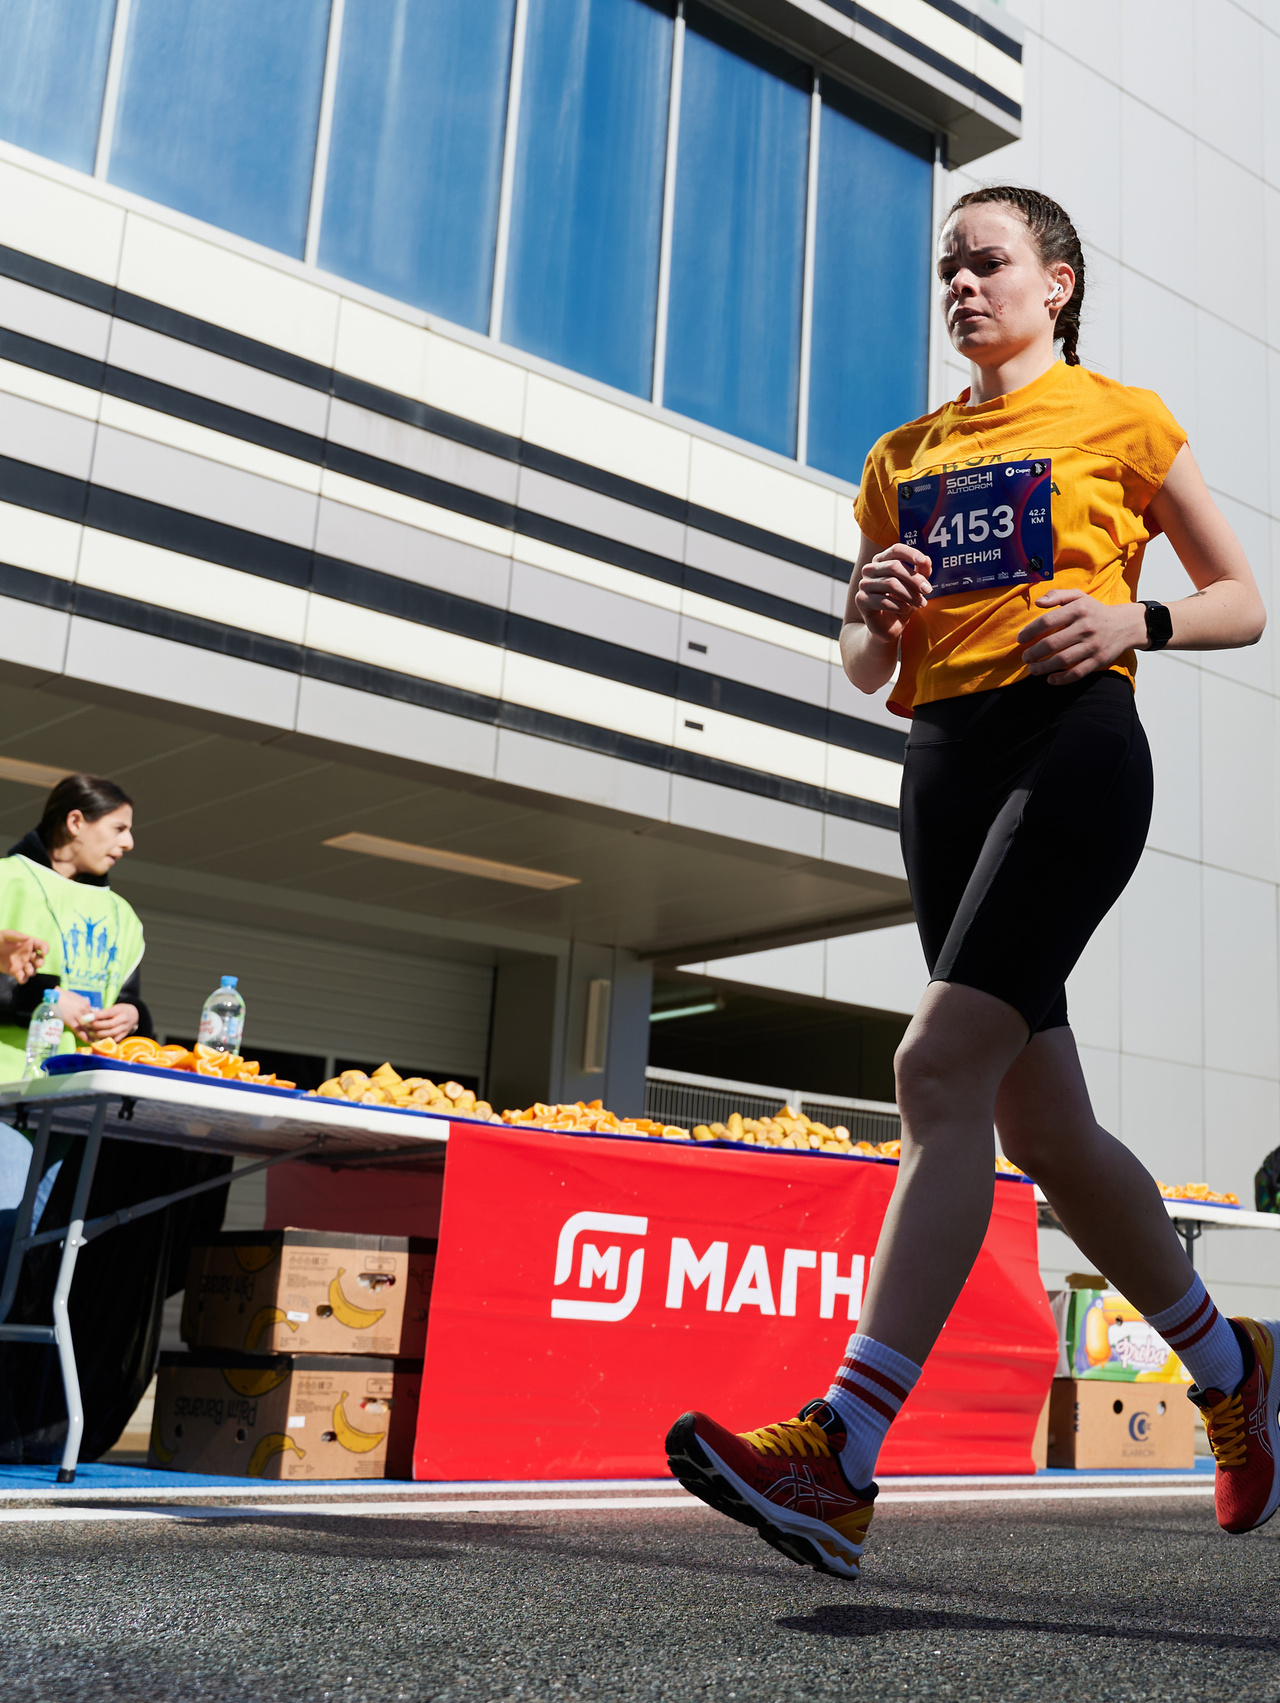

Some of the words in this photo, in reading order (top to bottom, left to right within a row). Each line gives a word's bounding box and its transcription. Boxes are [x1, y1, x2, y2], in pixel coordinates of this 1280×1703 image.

[946, 471, 993, 489] SOCHI
[946, 482, 994, 496] AUTODROM
[1029, 508, 1046, 517] 42.2
[904, 530, 918, 539] 42.2
[927, 504, 1015, 548] 4153
[942, 548, 1002, 569] ЕВГЕНИЯ
[665, 1237, 876, 1321] МАГН
